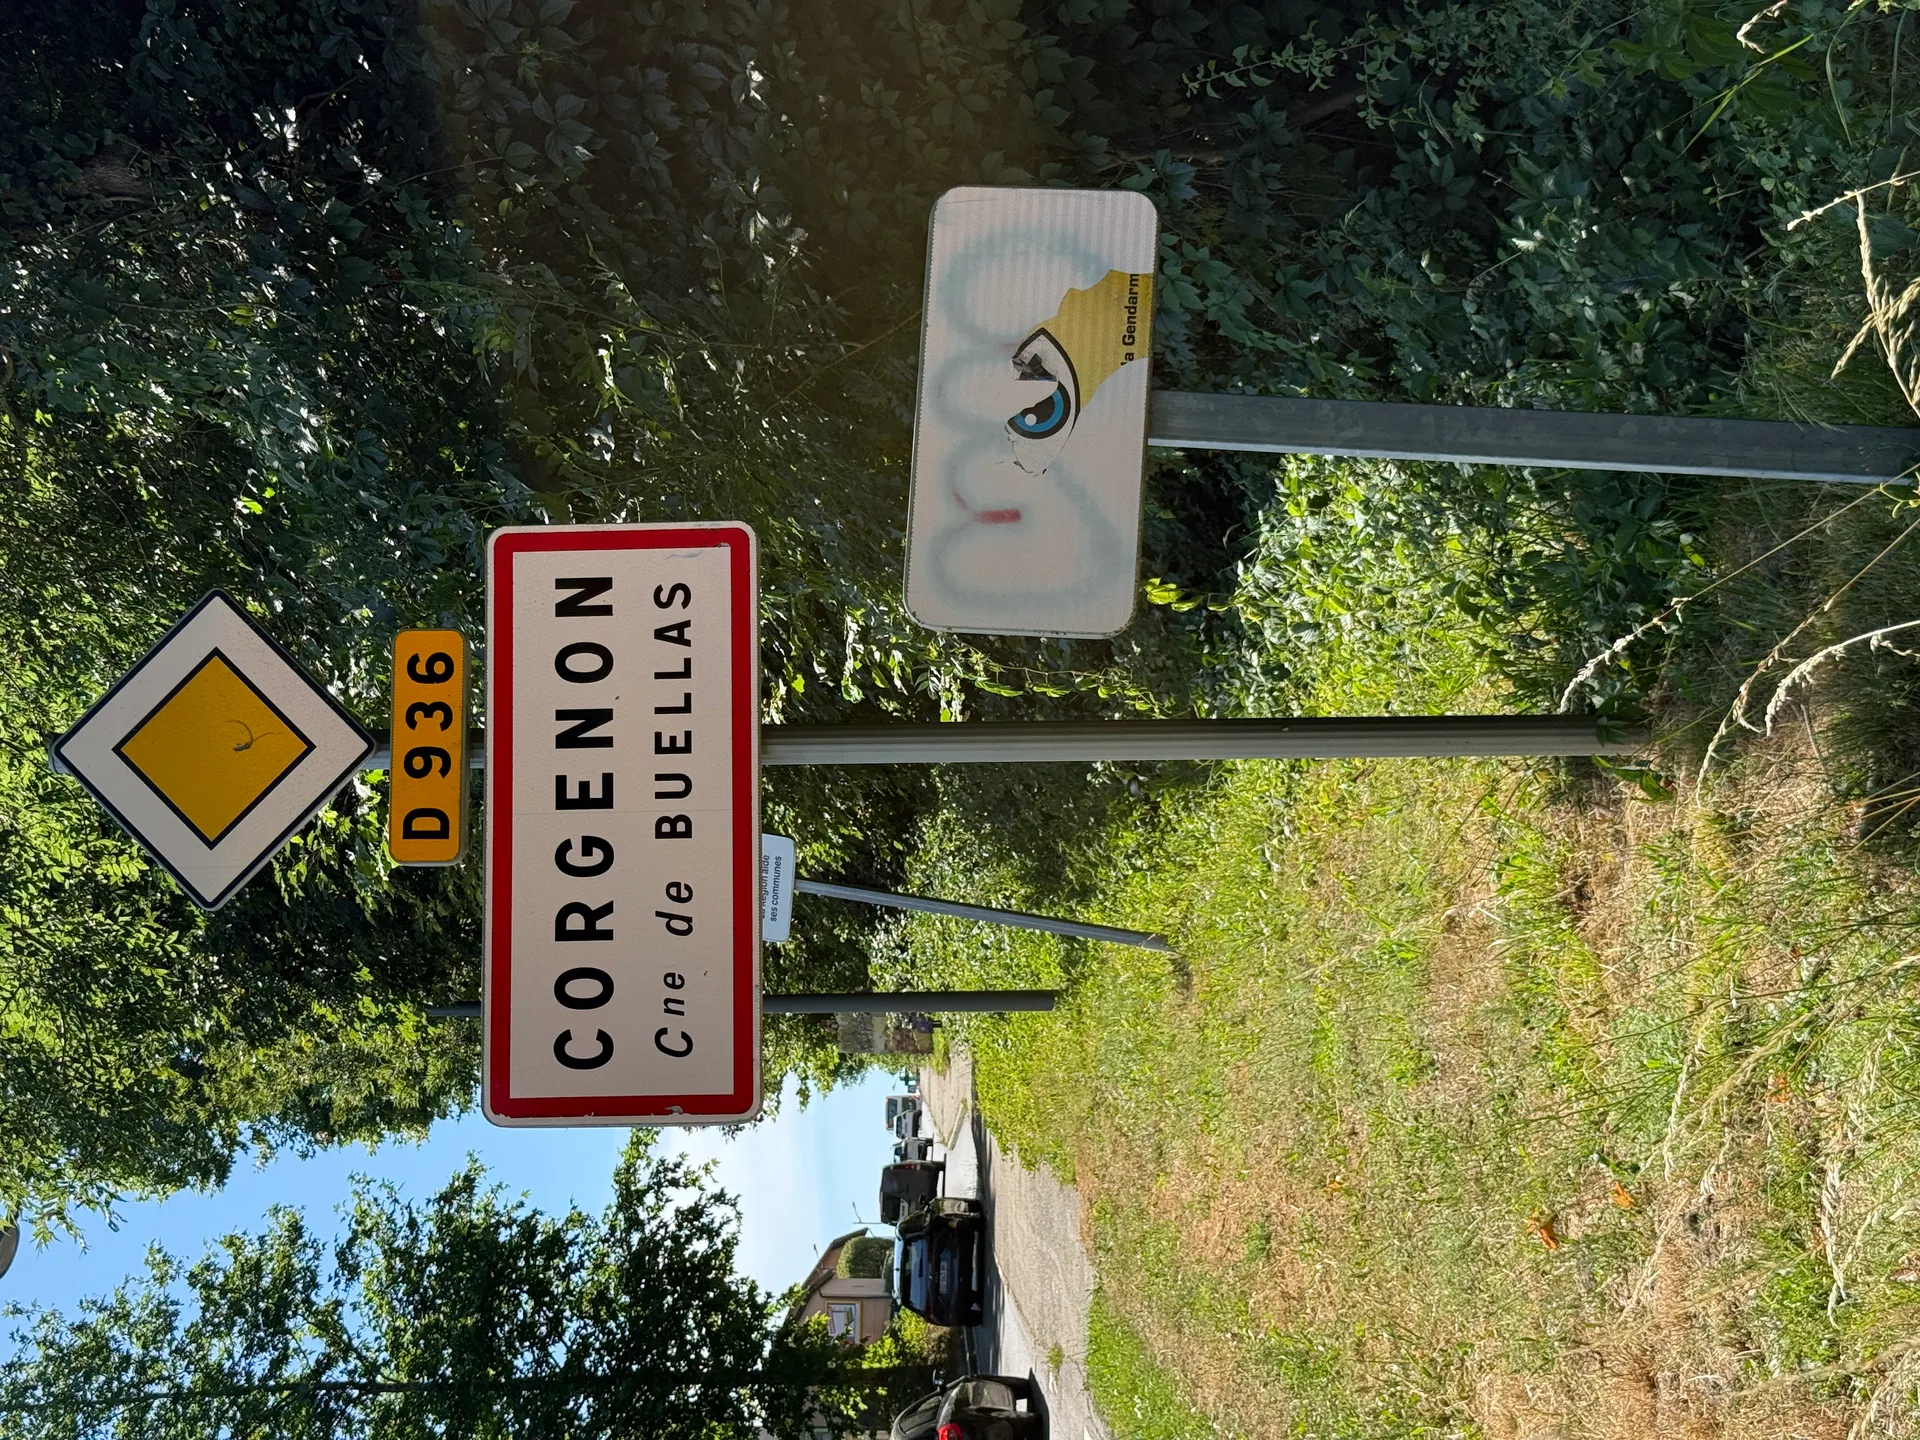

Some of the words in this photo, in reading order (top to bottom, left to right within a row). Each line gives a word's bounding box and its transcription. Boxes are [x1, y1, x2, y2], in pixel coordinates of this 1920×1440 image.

[1121, 273, 1140, 347] Gendarm
[403, 651, 455, 780] 936
[653, 582, 693, 840] BUELLAS
[402, 807, 450, 840] D
[553, 576, 615, 1070] CORGENON
[762, 854, 770, 875] aide
[771, 856, 782, 906] communes
[654, 880, 694, 937] de
[770, 906, 778, 922] ses
[654, 971, 694, 1058] Cne
